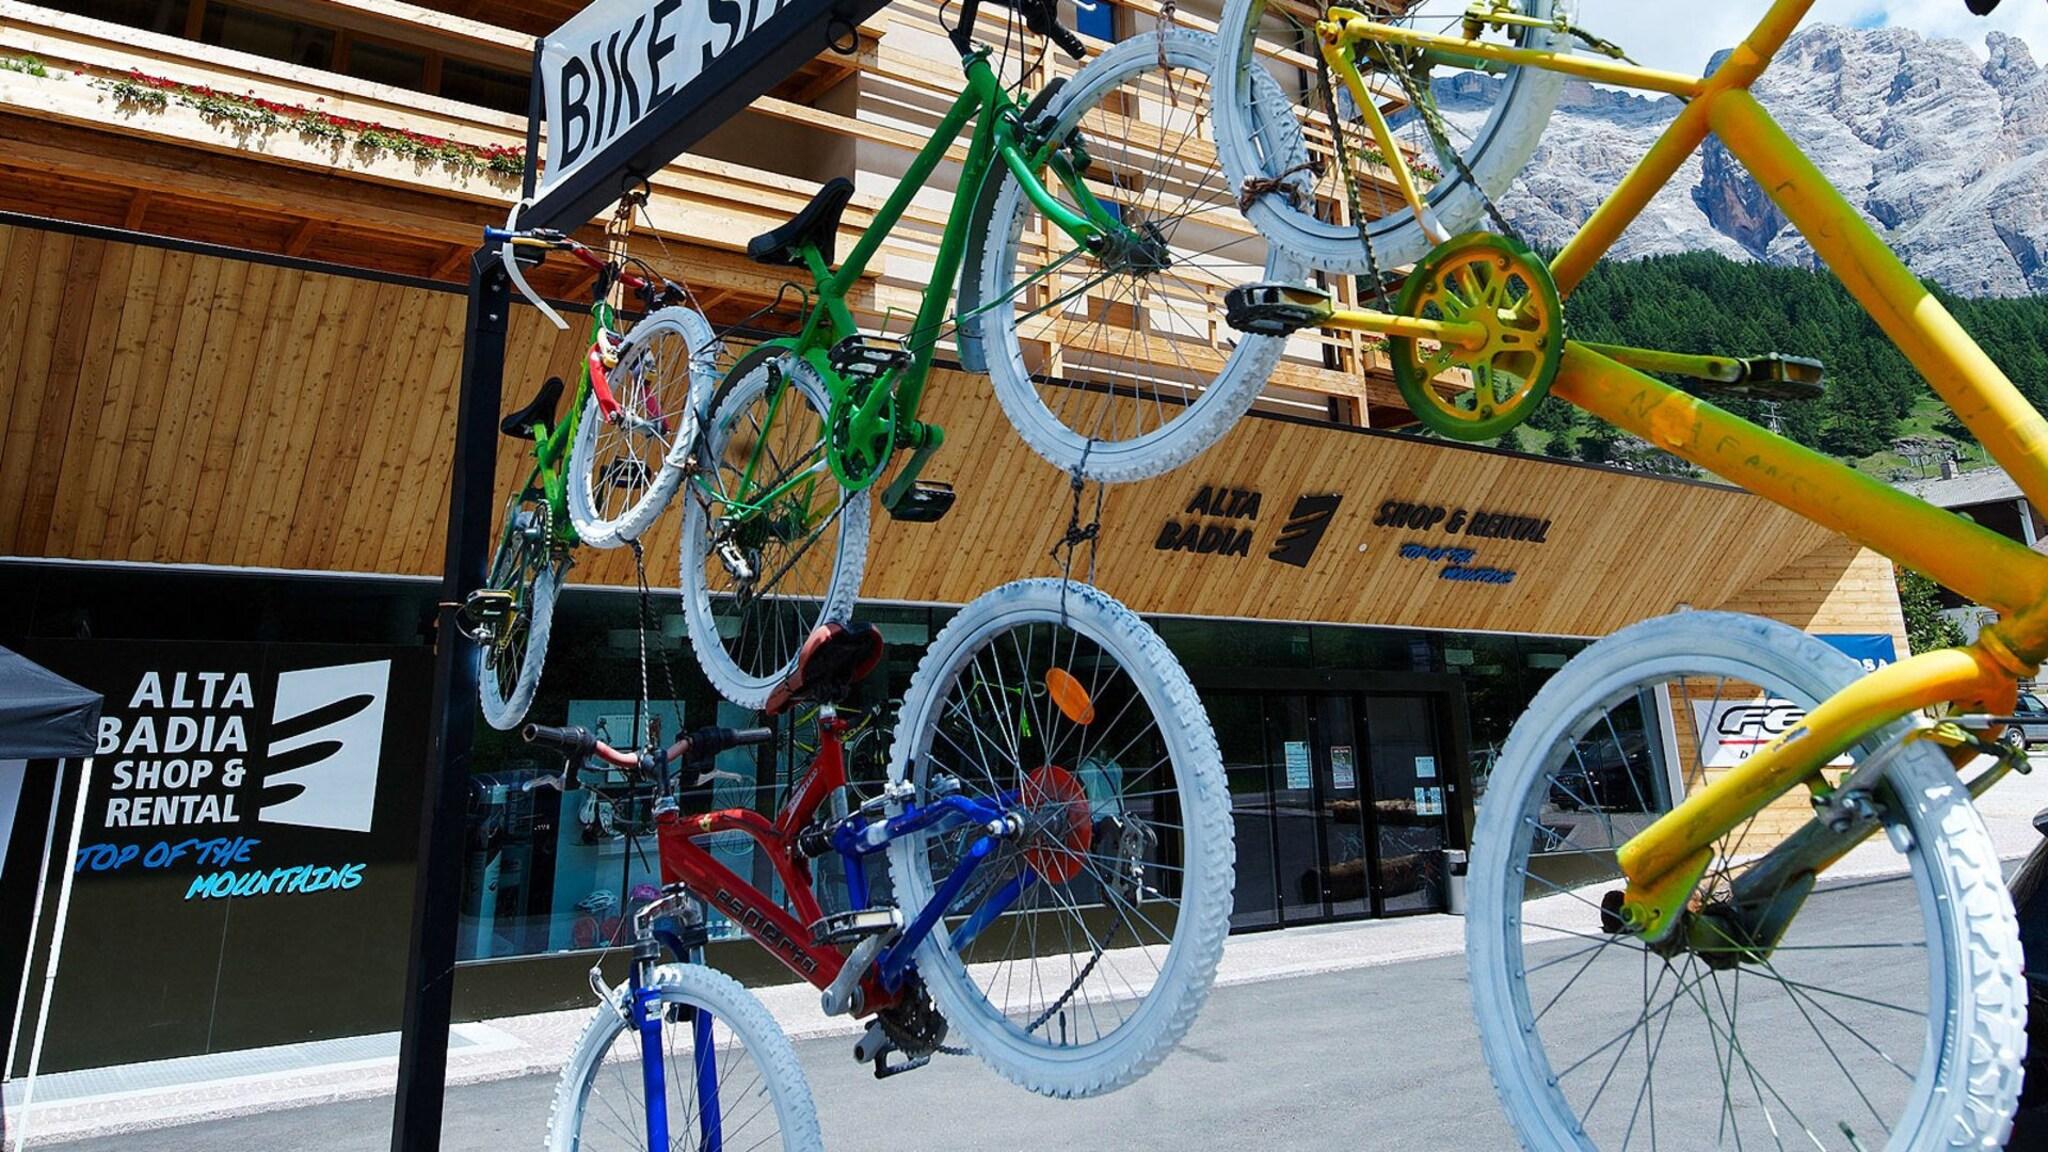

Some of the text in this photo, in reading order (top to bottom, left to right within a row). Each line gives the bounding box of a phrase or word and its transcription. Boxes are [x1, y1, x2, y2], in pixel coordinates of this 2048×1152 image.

[559, 0, 682, 172] BIKE
[1185, 486, 1262, 520] ALTA
[1154, 521, 1254, 557] BADIA
[1373, 501, 1552, 543] SHOP & RENTAL
[128, 671, 254, 709] ALTA
[96, 716, 249, 755] BADIA
[111, 760, 247, 790] SHOP &
[104, 794, 241, 828] RENTAL
[75, 836, 262, 873] TOP OF THE
[184, 863, 368, 900] MOUNTAINS
